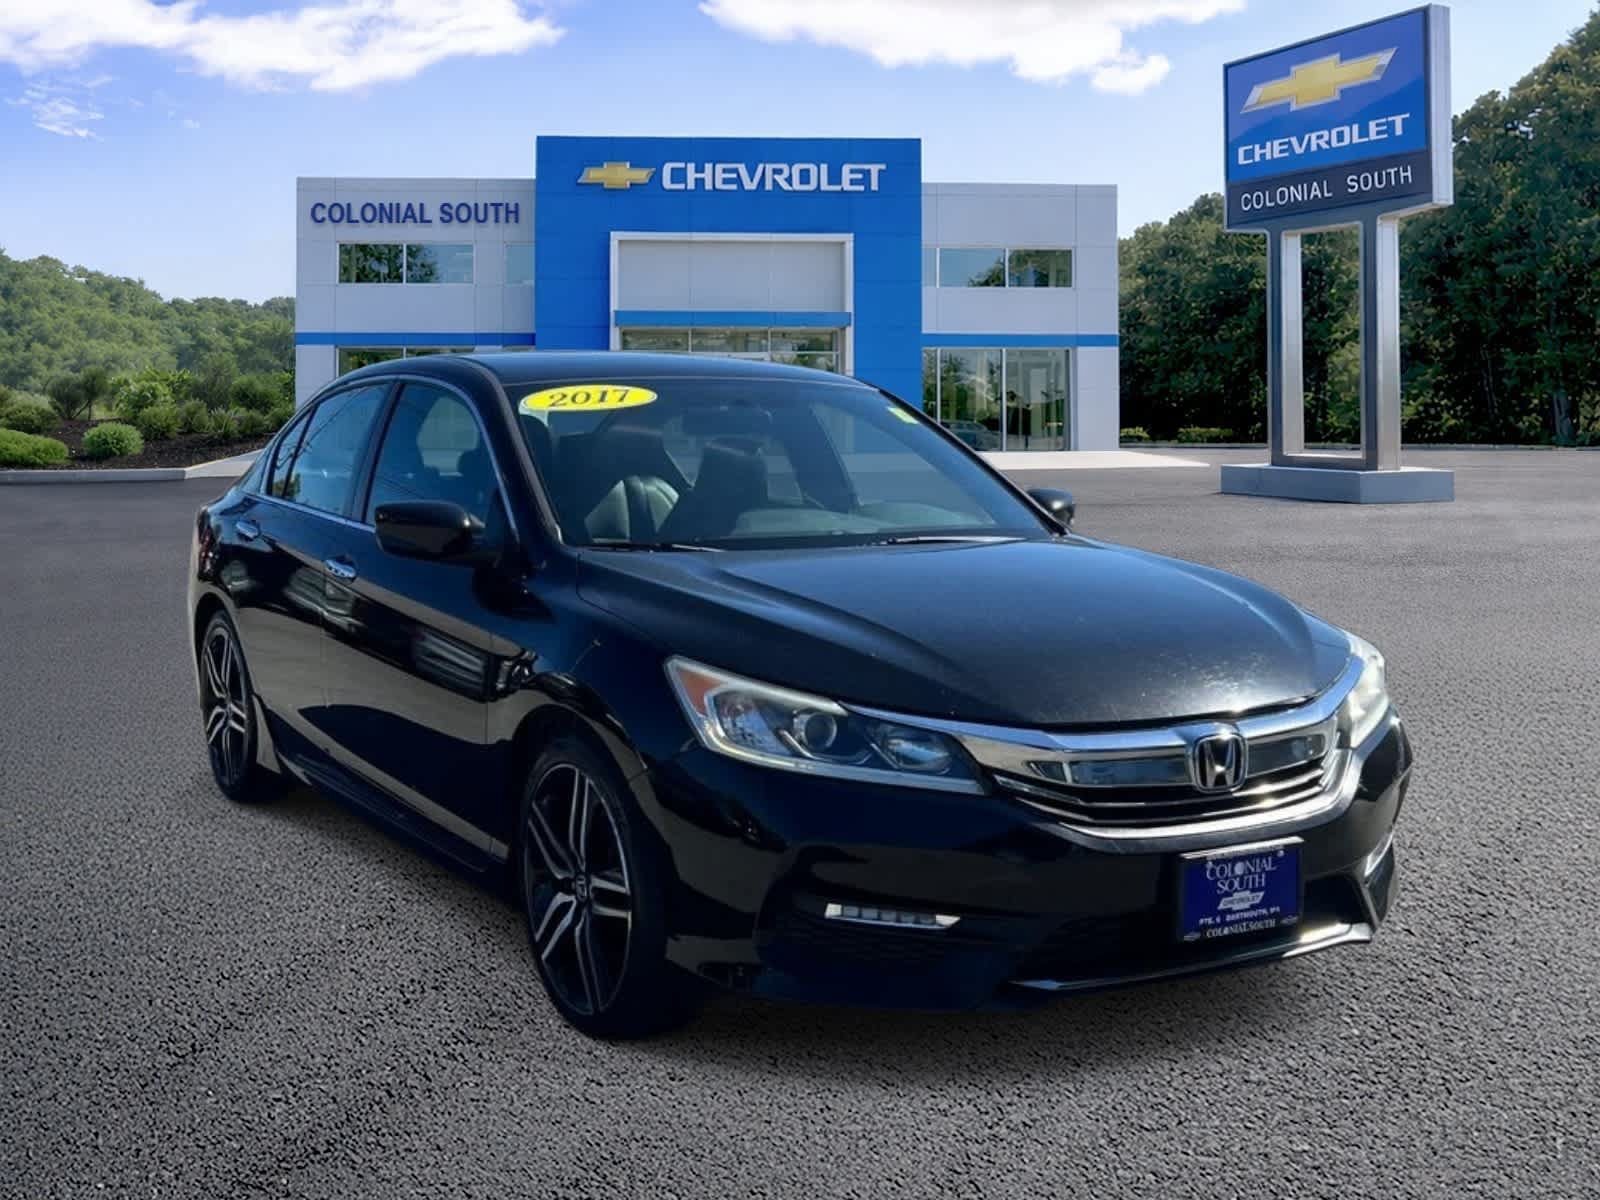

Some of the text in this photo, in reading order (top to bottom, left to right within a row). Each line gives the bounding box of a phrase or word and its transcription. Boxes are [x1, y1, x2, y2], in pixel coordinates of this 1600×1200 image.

[1237, 113, 1411, 165] CHEVROLET
[661, 161, 886, 192] CHEVROLET
[1241, 165, 1413, 211] COLONIAL SOUTH
[311, 202, 521, 225] COLONIAL SOUTH
[548, 388, 630, 408] 2017
[1206, 857, 1277, 880] COLONIAL
[1217, 873, 1266, 894] SOUTH
